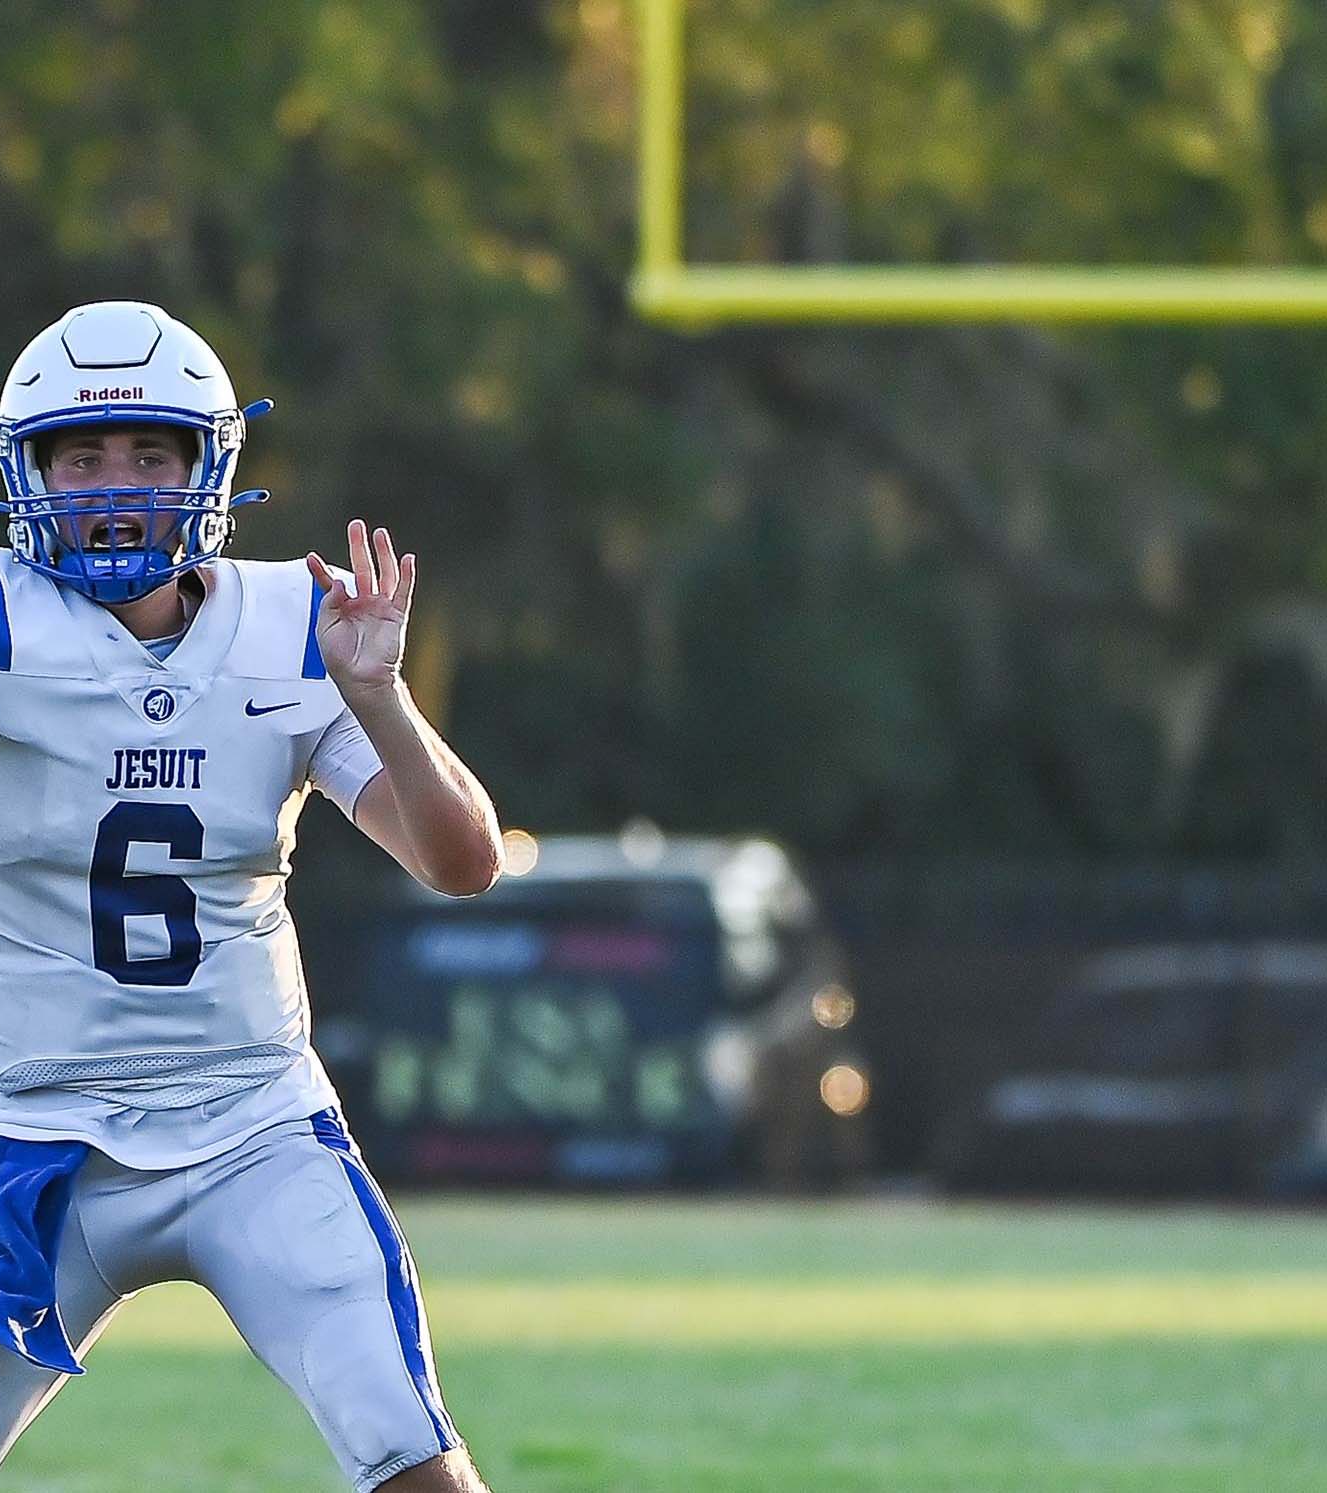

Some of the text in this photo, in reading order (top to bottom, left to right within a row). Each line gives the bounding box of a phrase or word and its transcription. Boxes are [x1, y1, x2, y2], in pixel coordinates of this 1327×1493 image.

[79, 387, 143, 402] Riddell
[105, 748, 207, 789] JESUIT
[88, 800, 205, 987] 6
